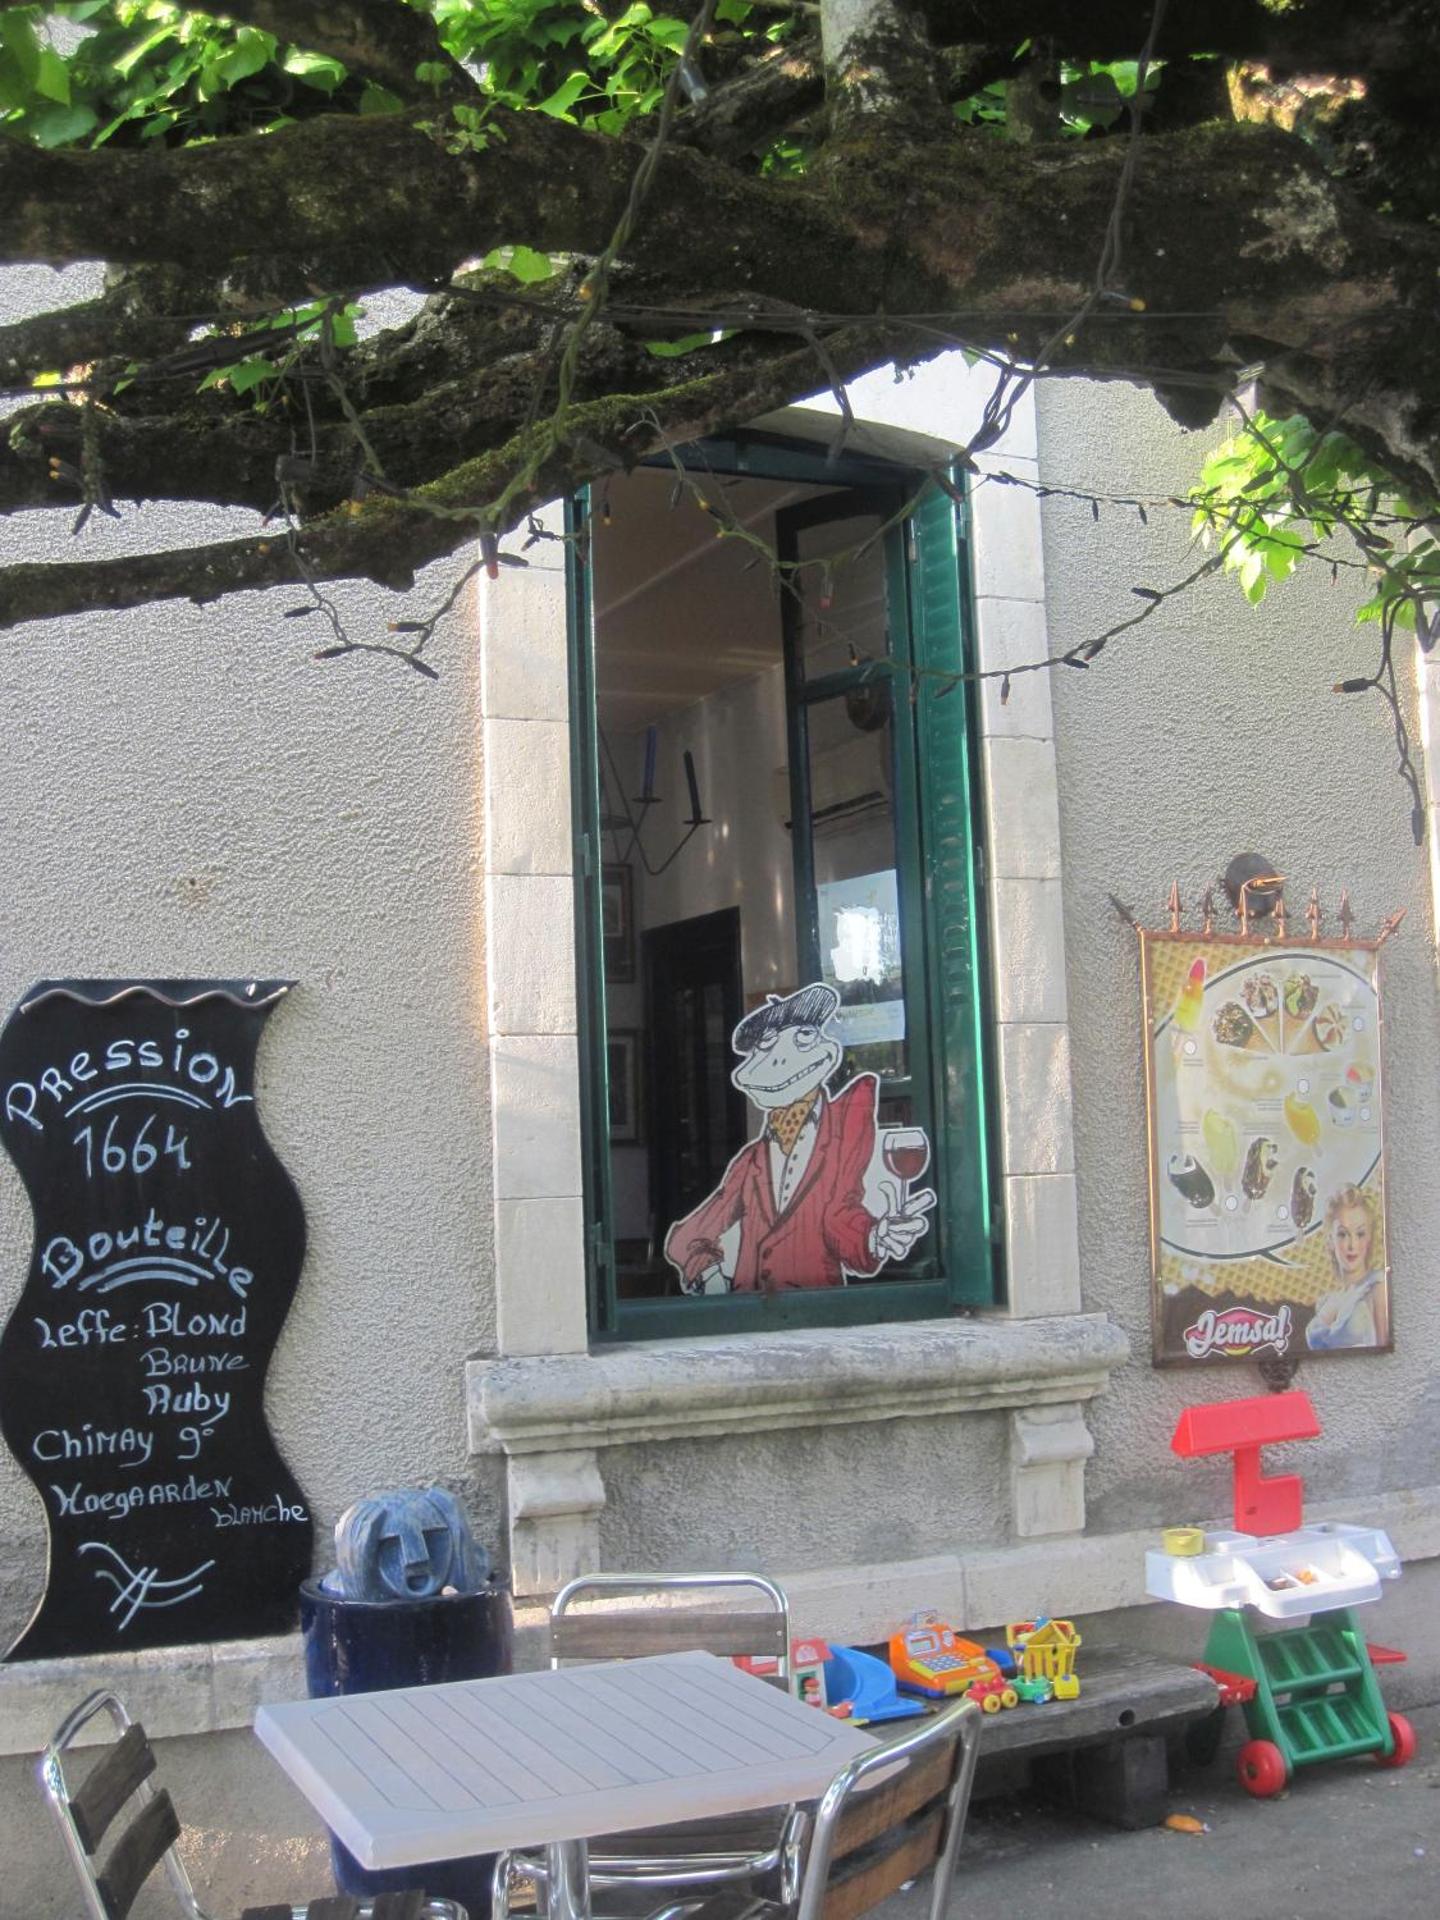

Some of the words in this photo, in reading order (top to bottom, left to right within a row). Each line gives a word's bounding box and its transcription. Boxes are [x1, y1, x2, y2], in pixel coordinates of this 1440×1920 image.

[73, 1114, 192, 1178] 1664
[41, 1208, 254, 1298] Bouteille
[141, 1382, 231, 1426] Ruby
